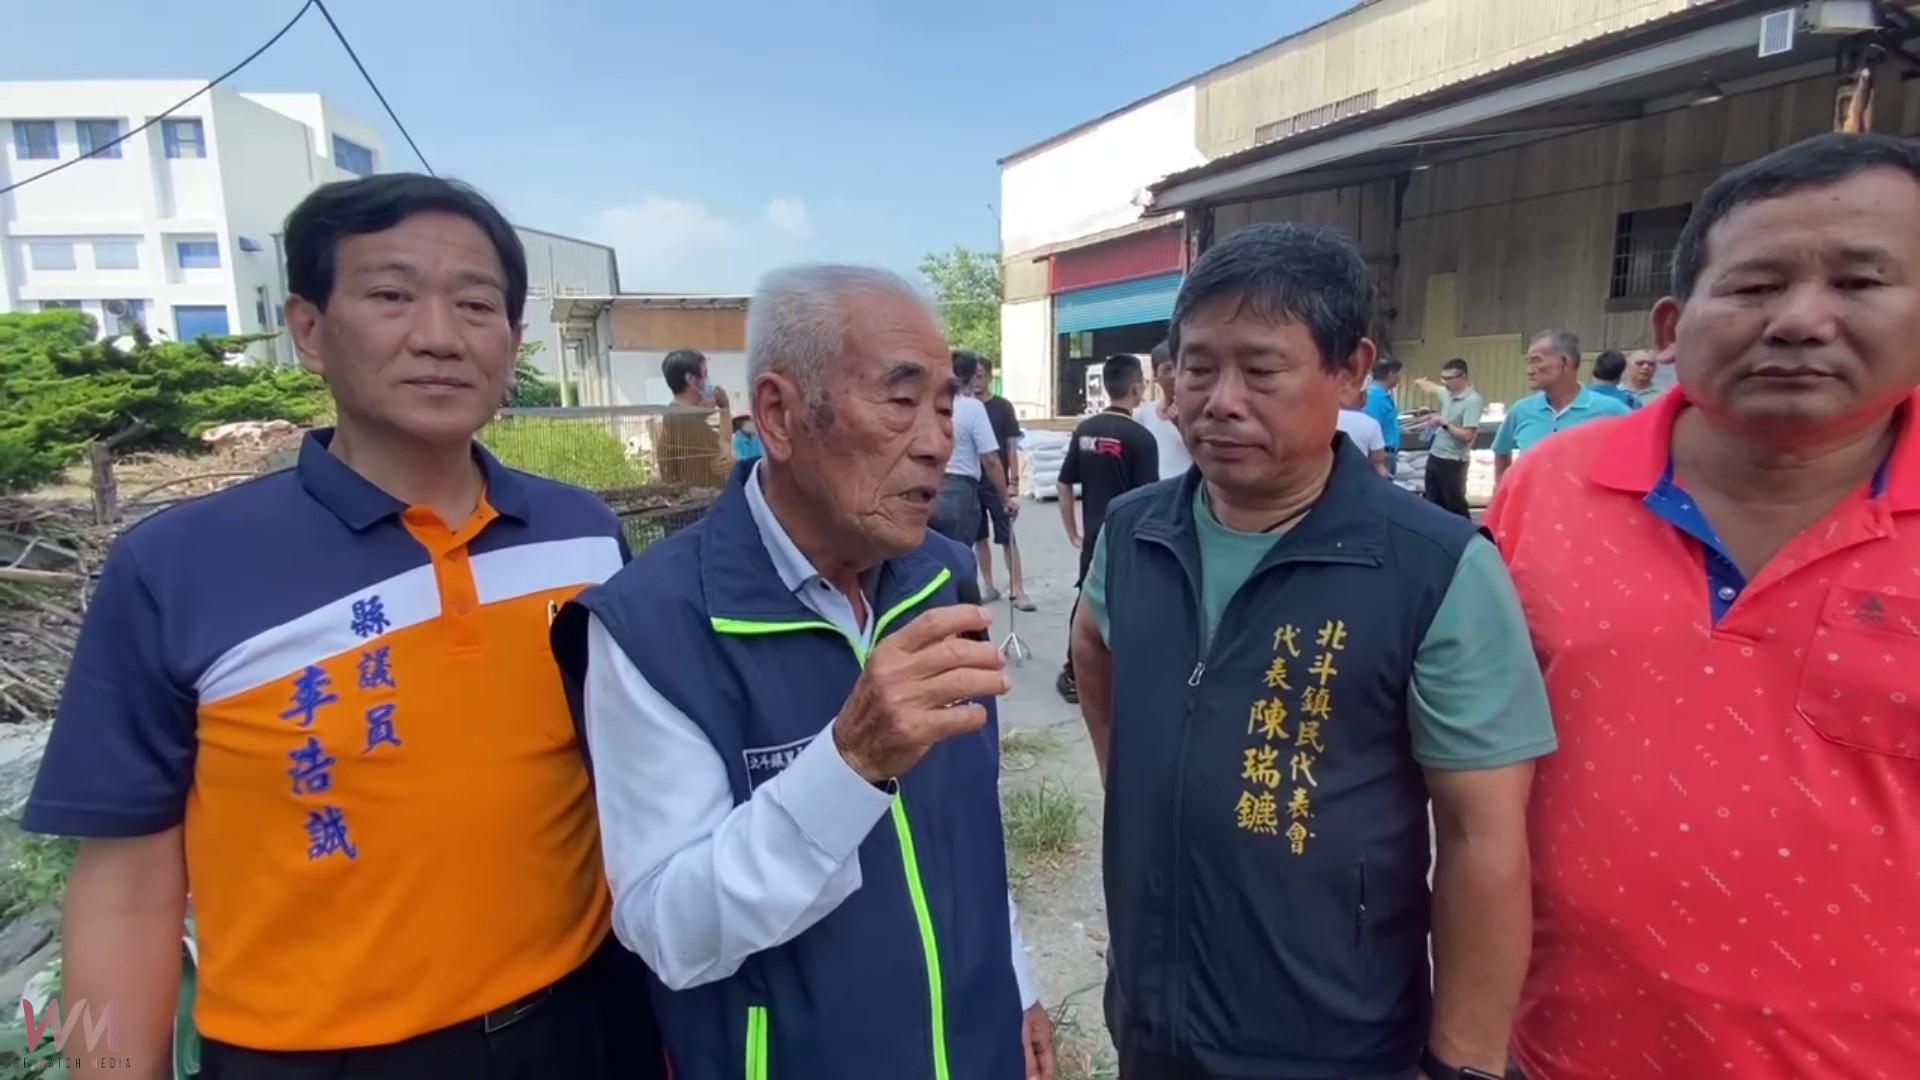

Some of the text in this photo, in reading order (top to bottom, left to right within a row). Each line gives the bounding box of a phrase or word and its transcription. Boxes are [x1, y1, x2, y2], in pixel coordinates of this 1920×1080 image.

[279, 664, 358, 861] 李浩誠
[350, 595, 402, 755] 縣議員
[1285, 619, 1348, 855] 北斗鎮民代表會
